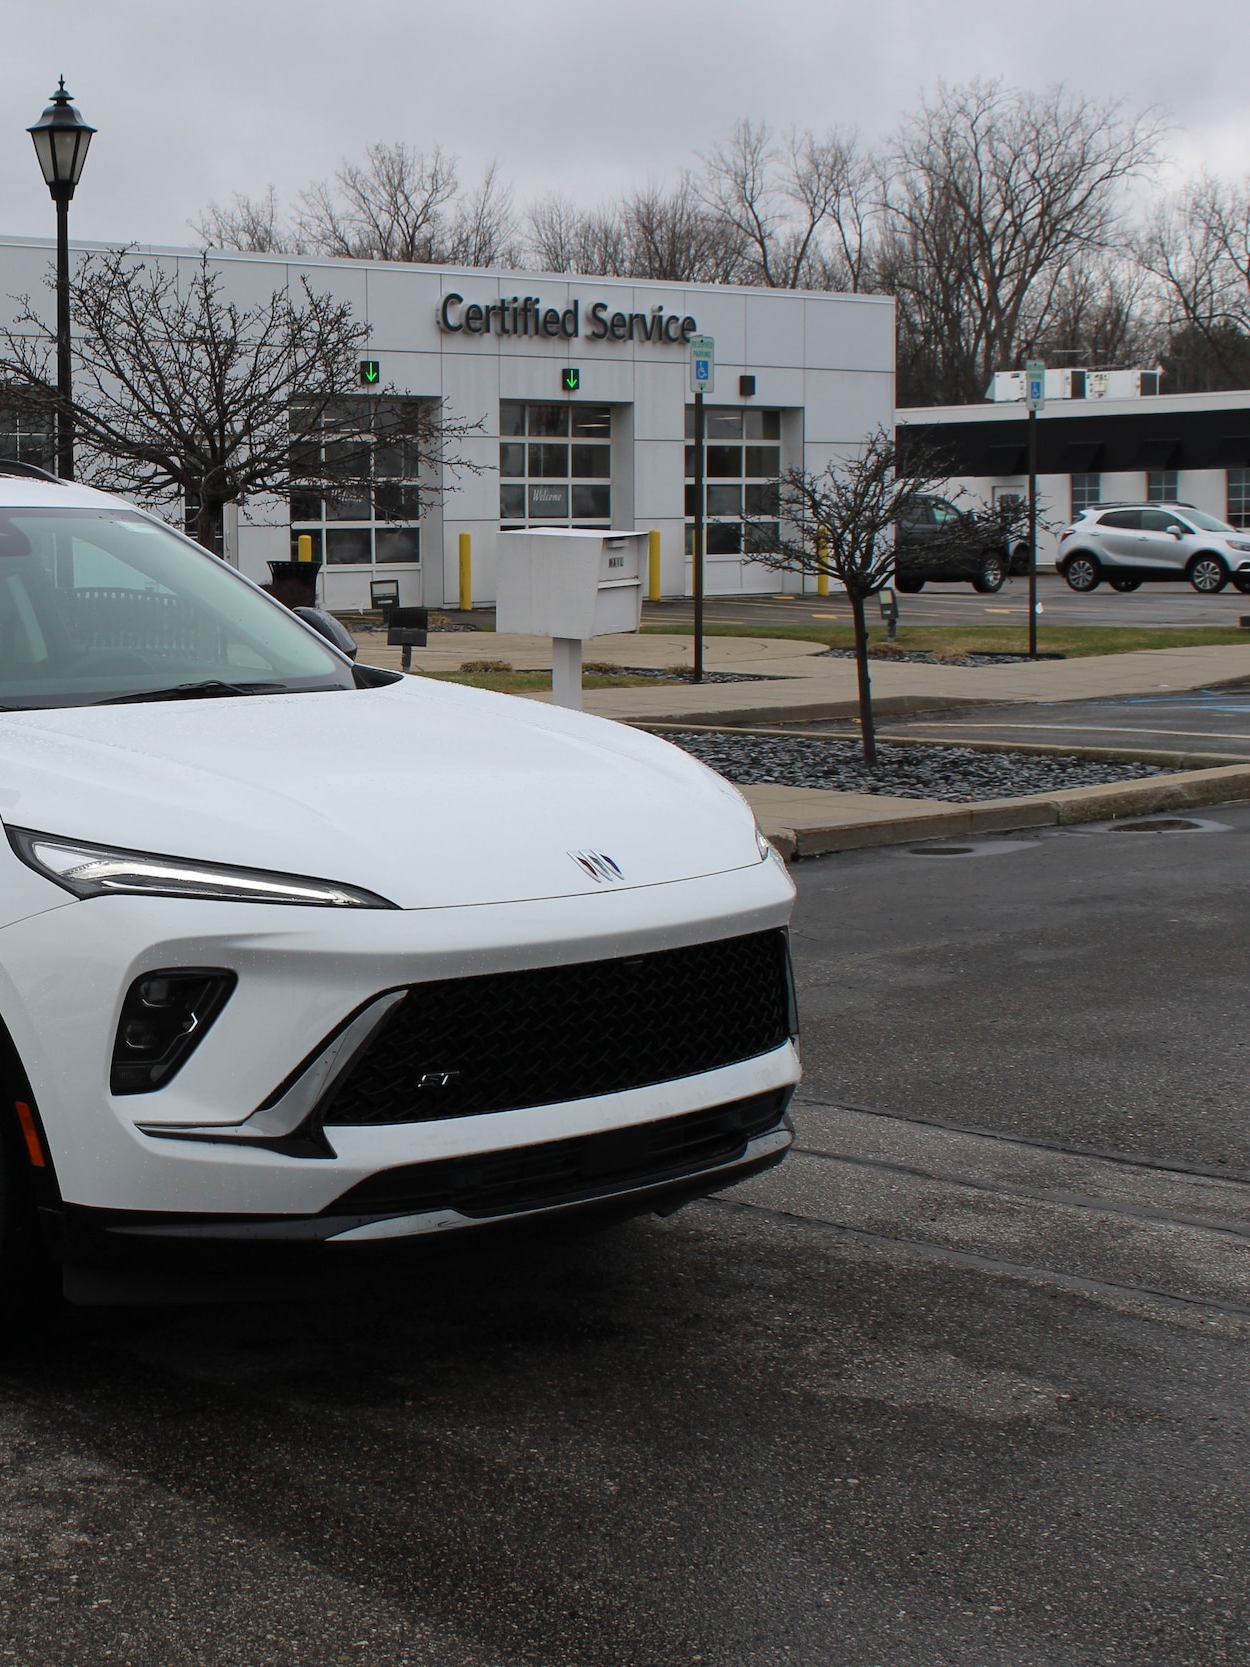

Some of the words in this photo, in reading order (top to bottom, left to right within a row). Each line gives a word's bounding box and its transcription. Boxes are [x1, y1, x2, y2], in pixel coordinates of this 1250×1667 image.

[439, 293, 579, 338] Certified
[588, 302, 697, 343] Service
[533, 489, 562, 501] Welcome
[608, 557, 624, 568] MAIL
[417, 1071, 460, 1087] ST
